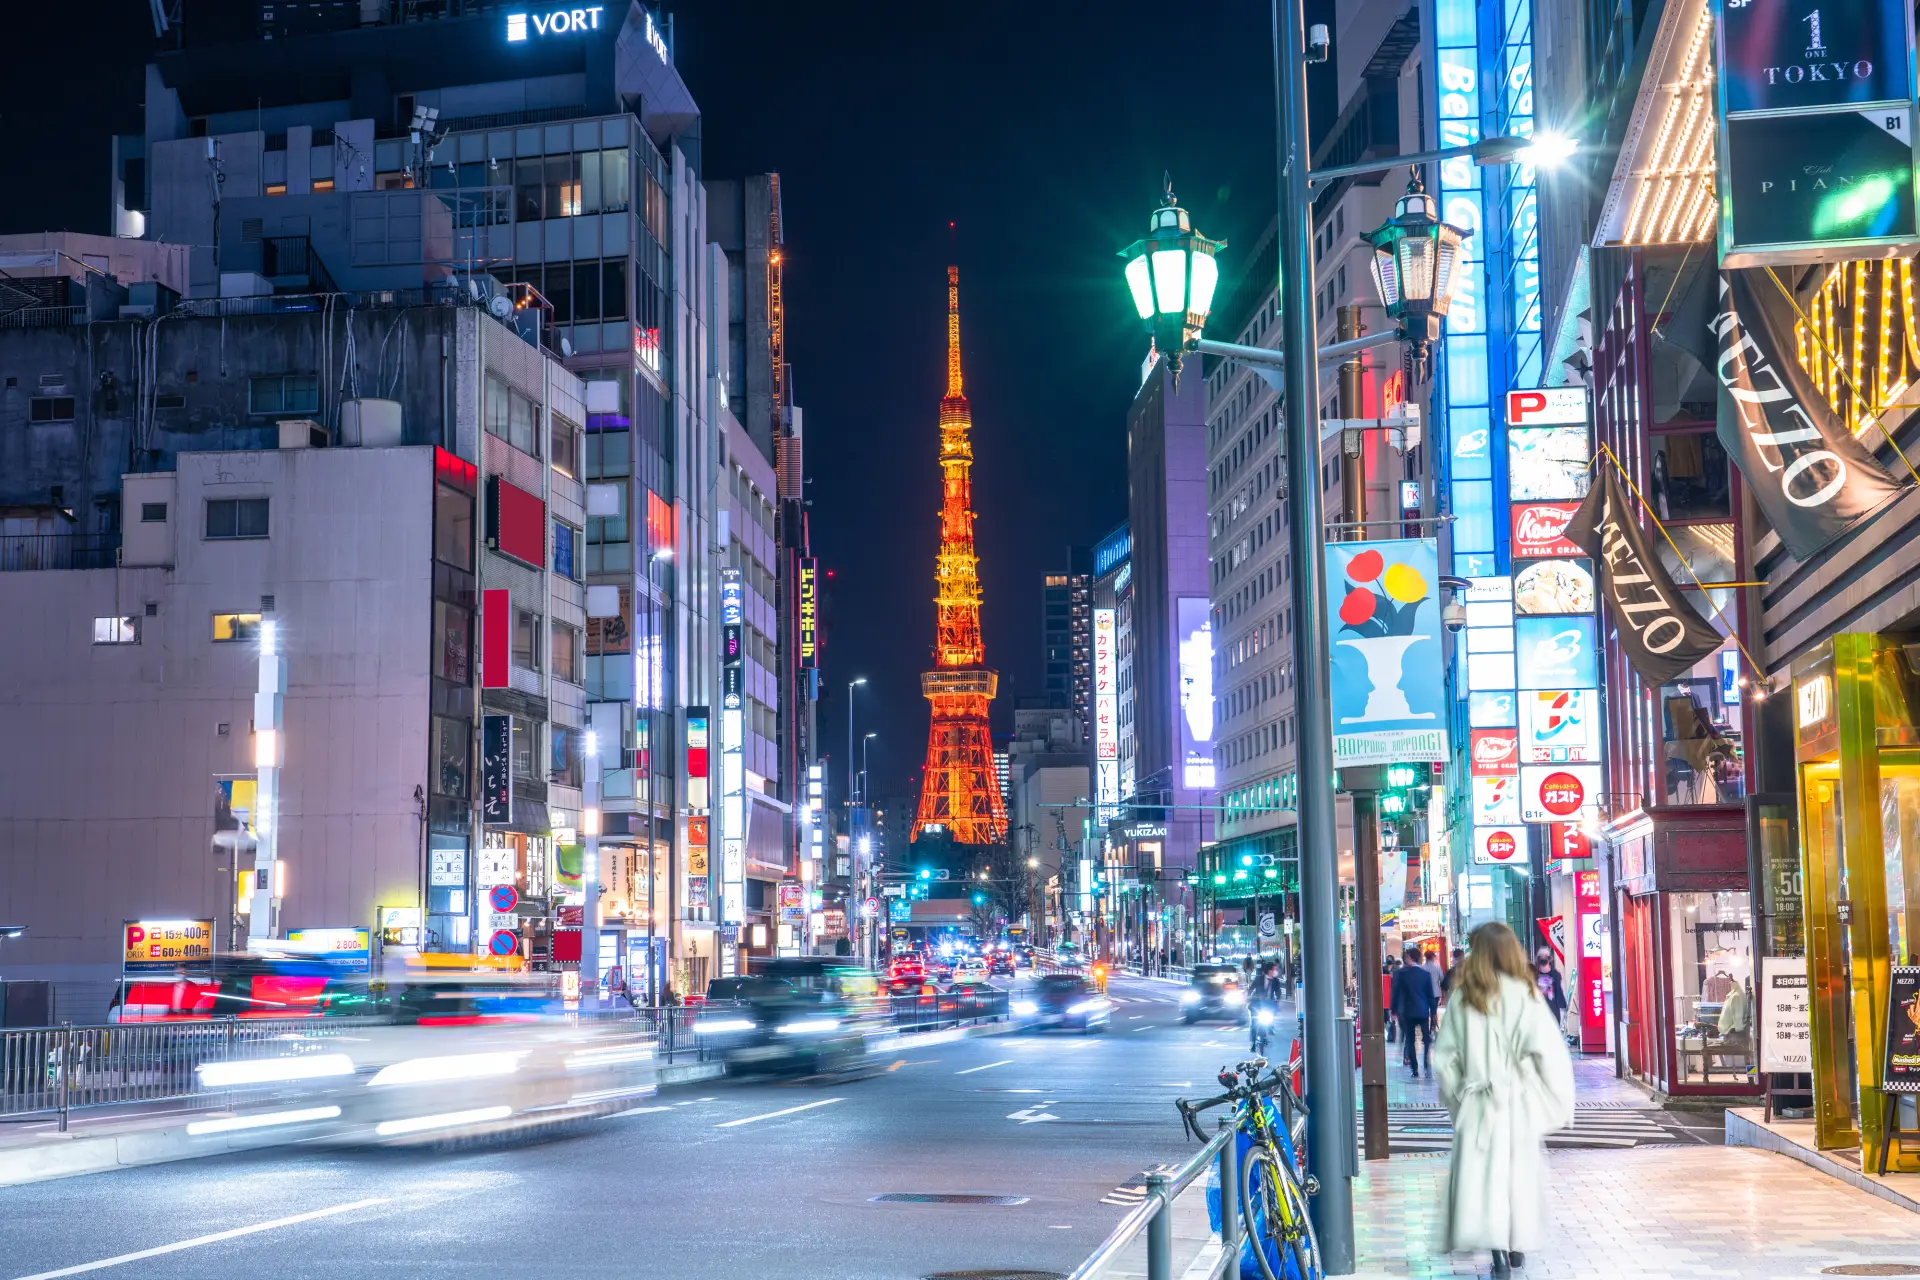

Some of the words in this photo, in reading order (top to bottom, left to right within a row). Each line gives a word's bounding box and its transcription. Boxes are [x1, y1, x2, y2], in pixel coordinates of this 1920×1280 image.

[533, 7, 603, 35] VORT
[1802, 9, 1827, 50] 1
[651, 25, 667, 65] VORT
[1805, 50, 1828, 58] ONE
[1763, 60, 1873, 85] TOKYO
[1886, 116, 1901, 130] B1
[1803, 165, 1833, 175] Club
[1761, 174, 1881, 193] PIAN
[1510, 393, 1546, 422] P
[1097, 634, 1109, 691] カラオケ
[1098, 698, 1110, 739] パセラ
[1545, 791, 1580, 804] ガスト
[1525, 810, 1544, 818] B1F
[1124, 828, 1167, 837] YUKIZAKI
[1490, 844, 1513, 854] ガスト
[1776, 903, 1794, 911] 18:00
[127, 927, 145, 950] P
[165, 930, 182, 939] 15分
[184, 927, 209, 938] 400円
[162, 947, 182, 957] 60分
[184, 944, 209, 957] 400円
[1776, 977, 1808, 986] 本日の営業
[1783, 1055, 1807, 1063] MEZZO
